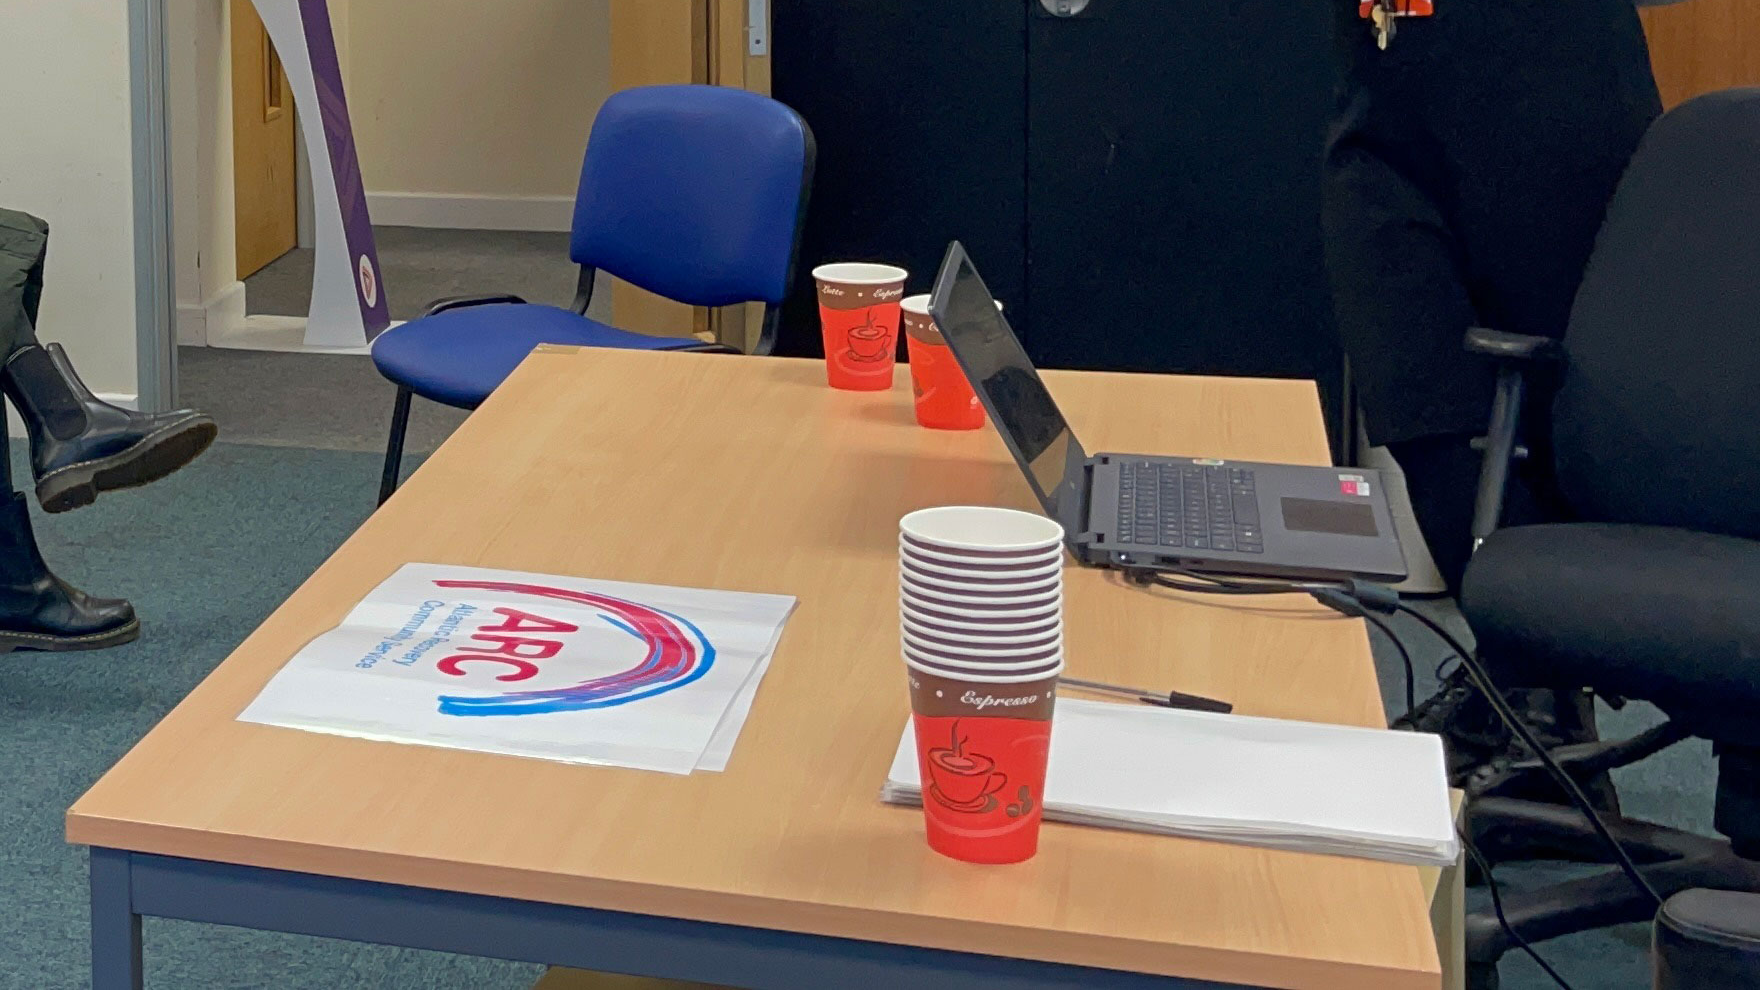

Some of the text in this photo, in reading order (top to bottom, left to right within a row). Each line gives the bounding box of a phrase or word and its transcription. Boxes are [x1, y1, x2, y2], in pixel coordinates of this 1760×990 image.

[821, 284, 845, 297] Latte
[436, 607, 579, 682] ARC
[960, 690, 1038, 710] Espresso
